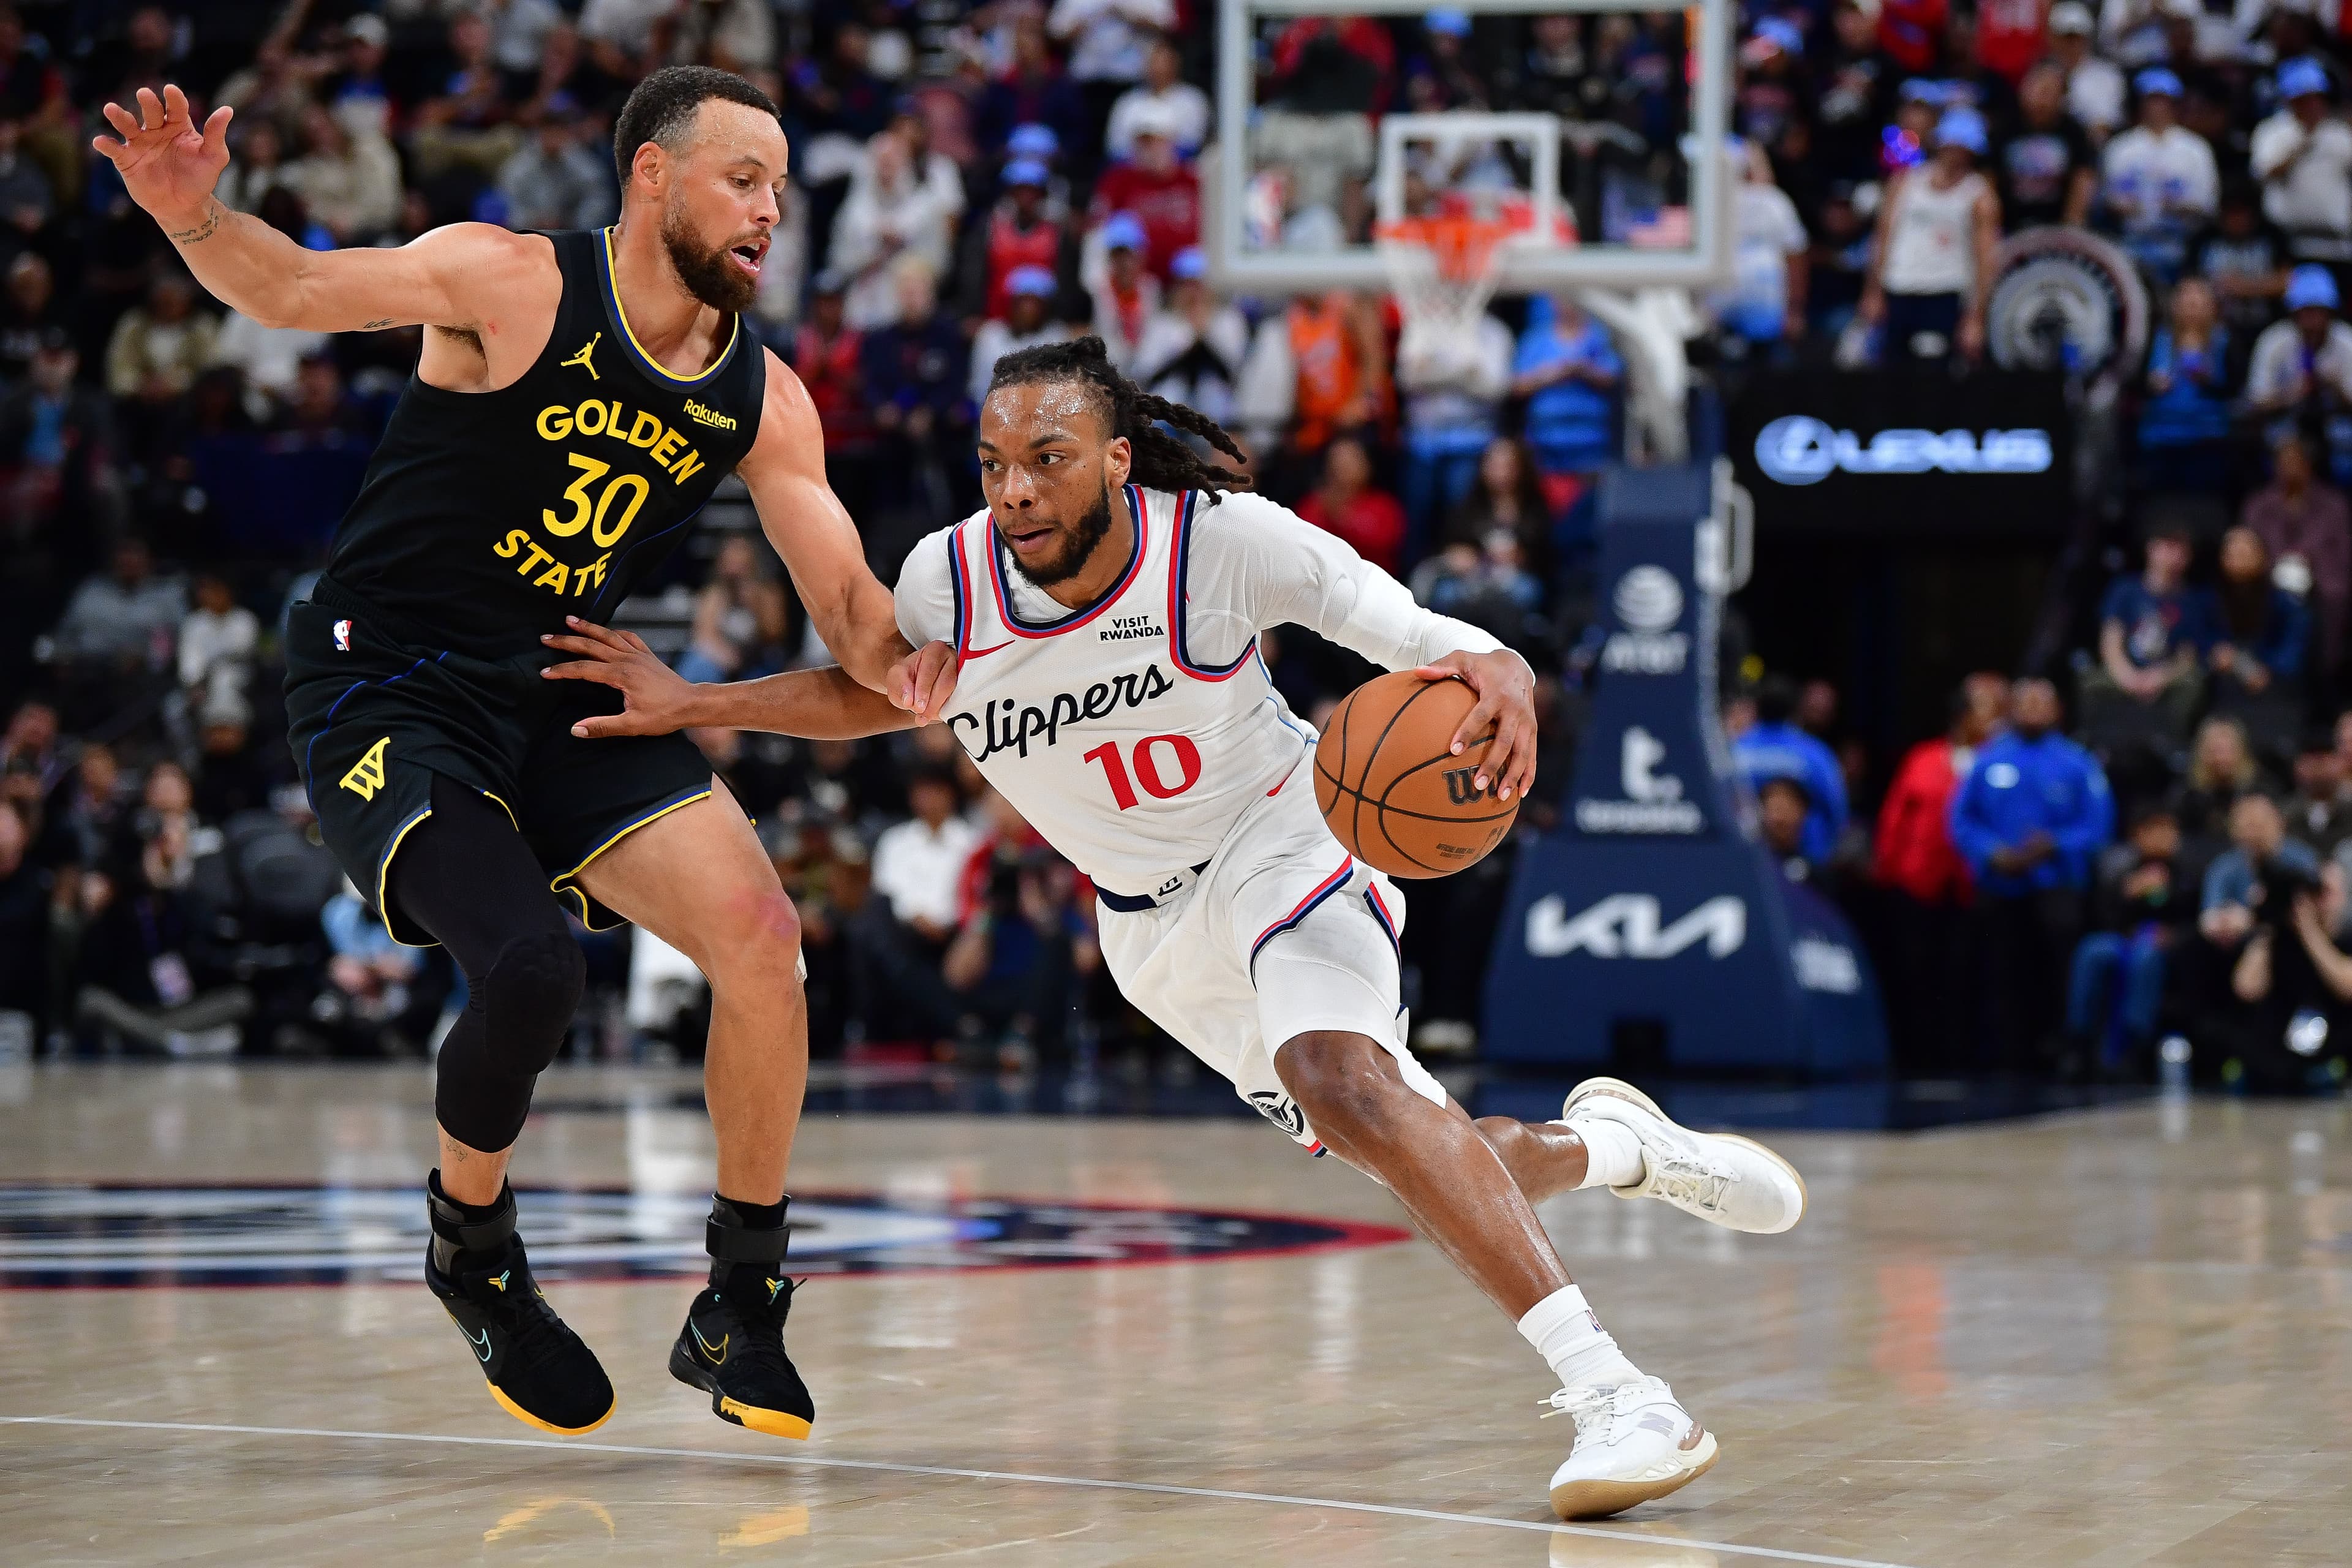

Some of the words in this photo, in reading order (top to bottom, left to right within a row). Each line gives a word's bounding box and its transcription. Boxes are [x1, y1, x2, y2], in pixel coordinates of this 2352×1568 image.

[536, 399, 706, 486] GOLDEN
[683, 399, 737, 430] Rakuten
[543, 451, 650, 548] 30
[493, 529, 612, 597] STATE
[1099, 625, 1164, 641] RWANDA
[1112, 615, 1149, 629] VISIT
[948, 663, 1174, 763] Clippers
[1084, 734, 1201, 812] 10
